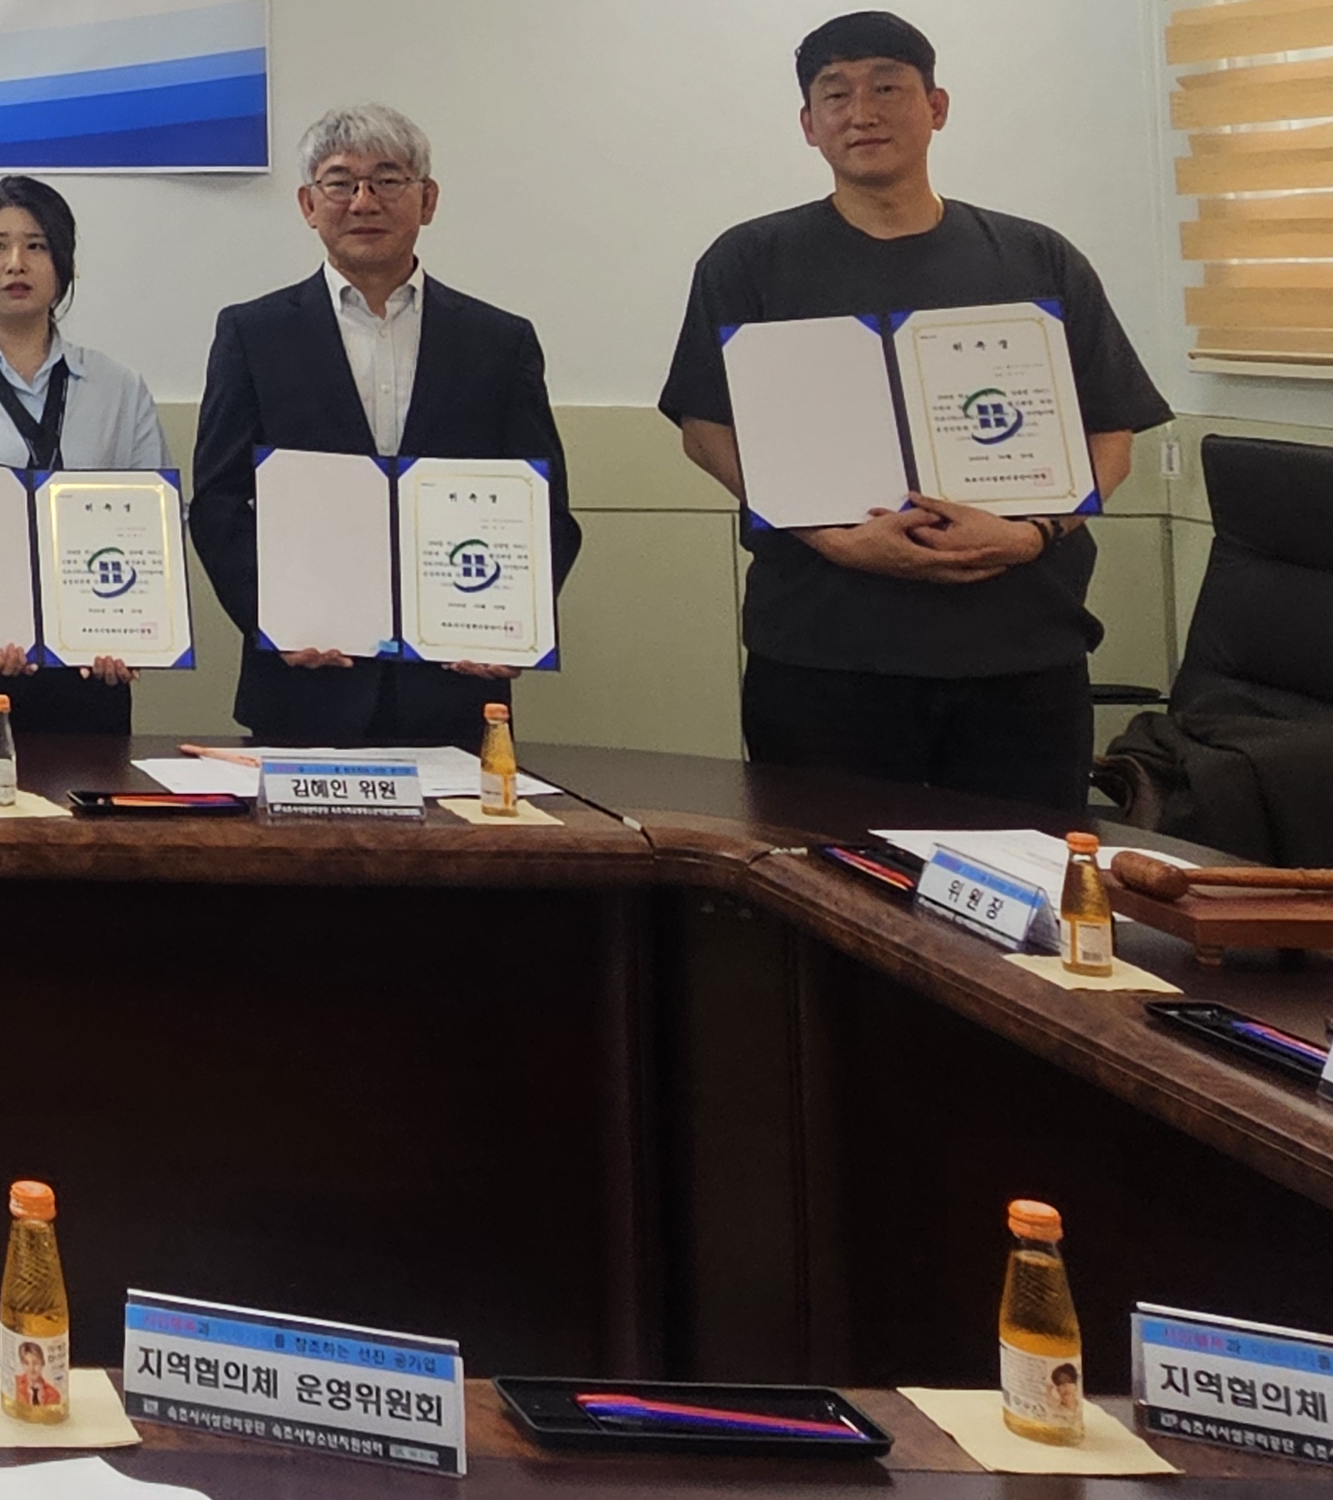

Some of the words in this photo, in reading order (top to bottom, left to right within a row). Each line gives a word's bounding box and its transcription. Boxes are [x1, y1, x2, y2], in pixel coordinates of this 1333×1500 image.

[358, 780, 397, 801] 위원
[136, 1345, 279, 1400] 지역협의체
[295, 1373, 443, 1427] 운영위원회
[1159, 1362, 1328, 1423] 지역협의체
